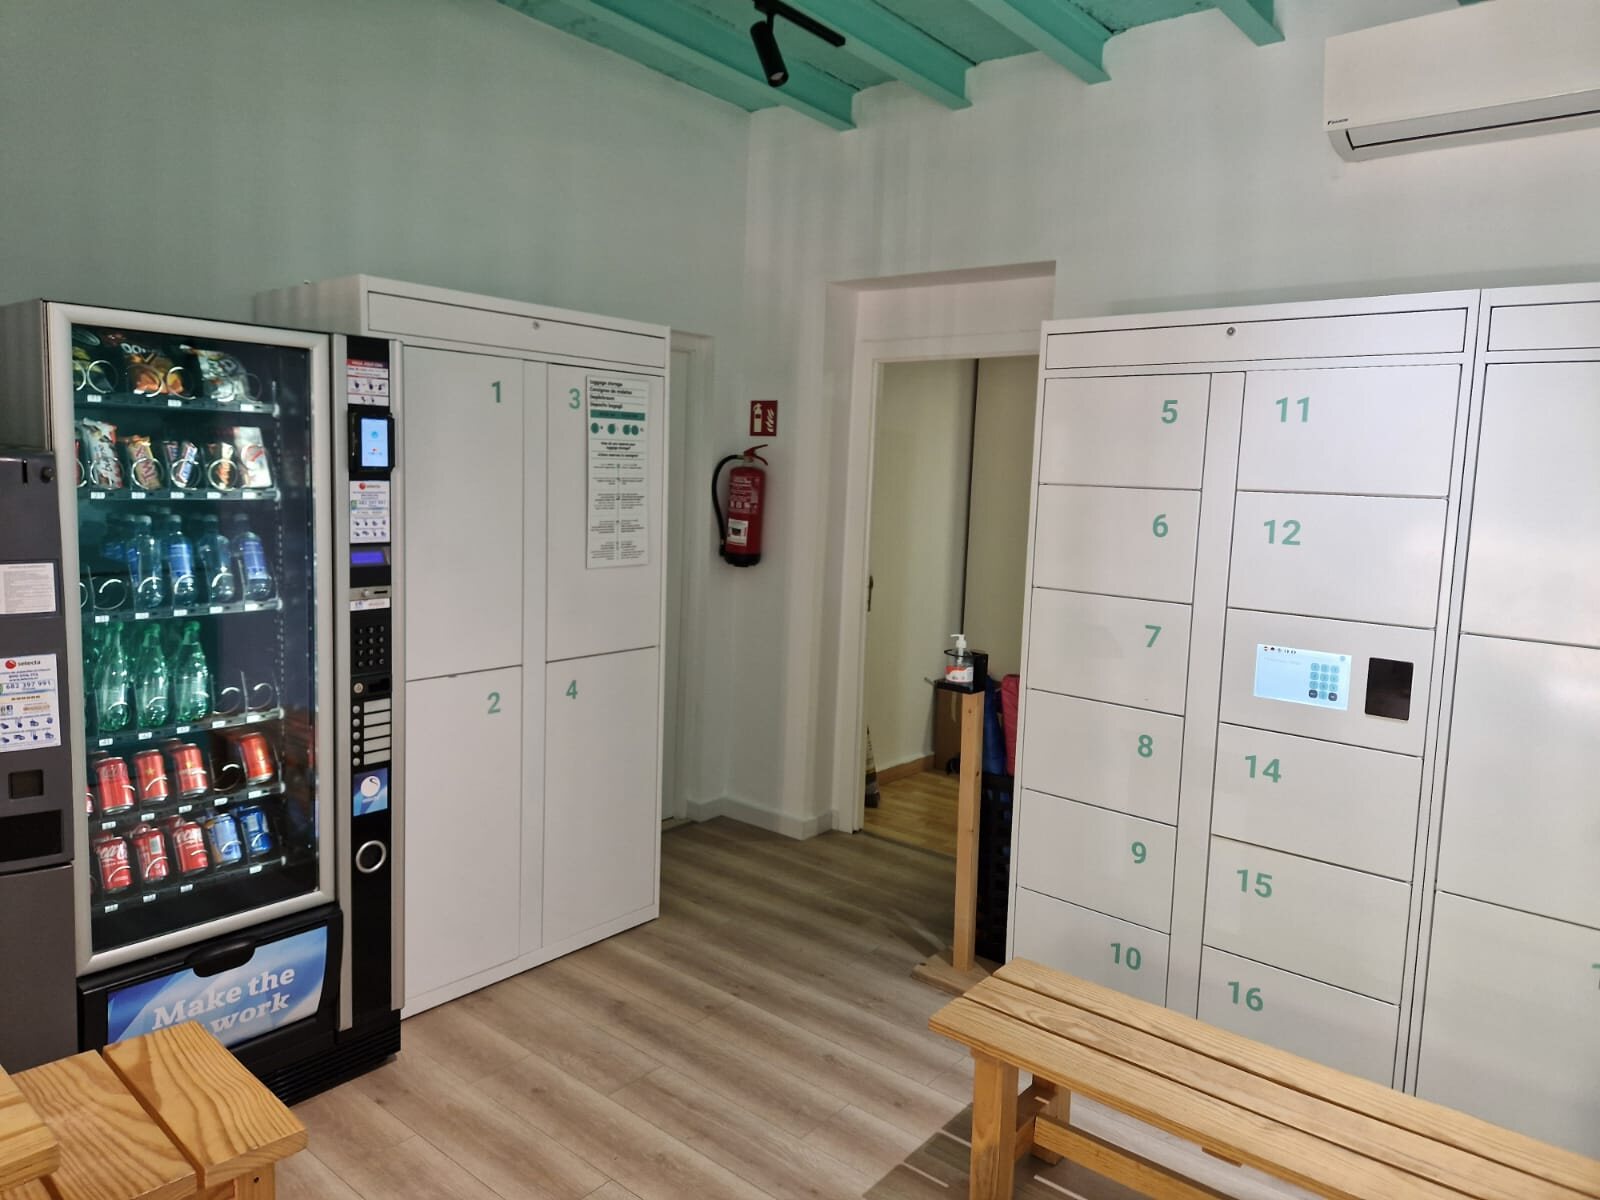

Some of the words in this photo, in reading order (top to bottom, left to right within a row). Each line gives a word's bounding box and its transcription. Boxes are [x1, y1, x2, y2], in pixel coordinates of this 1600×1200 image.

[491, 381, 502, 403] 1
[569, 387, 581, 411] 3
[1161, 399, 1178, 424] 5
[1275, 396, 1310, 423] 11
[1152, 514, 1169, 538] 6
[1263, 519, 1302, 546] 12
[1144, 624, 1162, 648] 7
[565, 680, 578, 699] 4
[487, 691, 501, 715] 2
[1137, 734, 1154, 759] 8
[1244, 754, 1282, 784] 14
[1130, 841, 1147, 865] 9
[1236, 868, 1273, 899] 15
[1110, 943, 1142, 971] 10
[151, 986, 242, 1031] Make
[247, 968, 296, 997] the
[1227, 980, 1264, 1012] 16
[210, 992, 290, 1033] work
